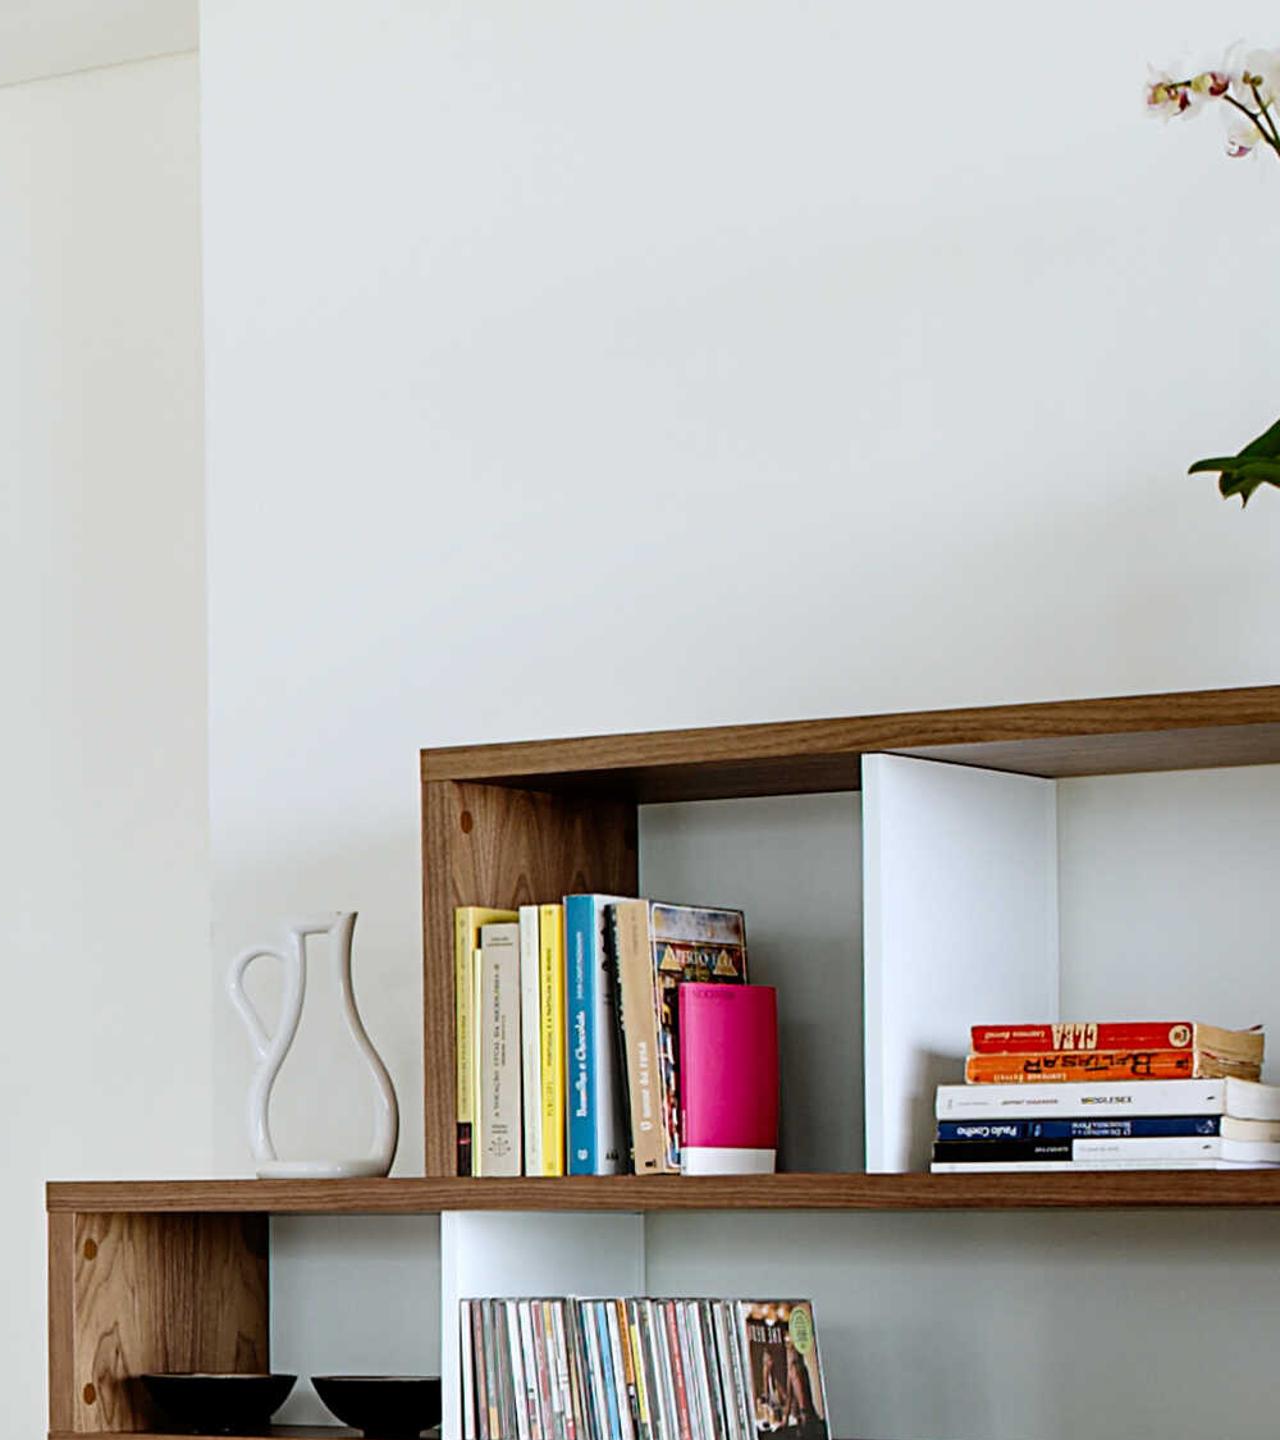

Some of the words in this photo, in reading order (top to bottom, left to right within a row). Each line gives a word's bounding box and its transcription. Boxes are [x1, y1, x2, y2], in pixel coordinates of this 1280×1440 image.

[1051, 1024, 1099, 1050] CLEA
[957, 1126, 989, 1137] Coelho
[991, 1125, 1017, 1137] Paulo
